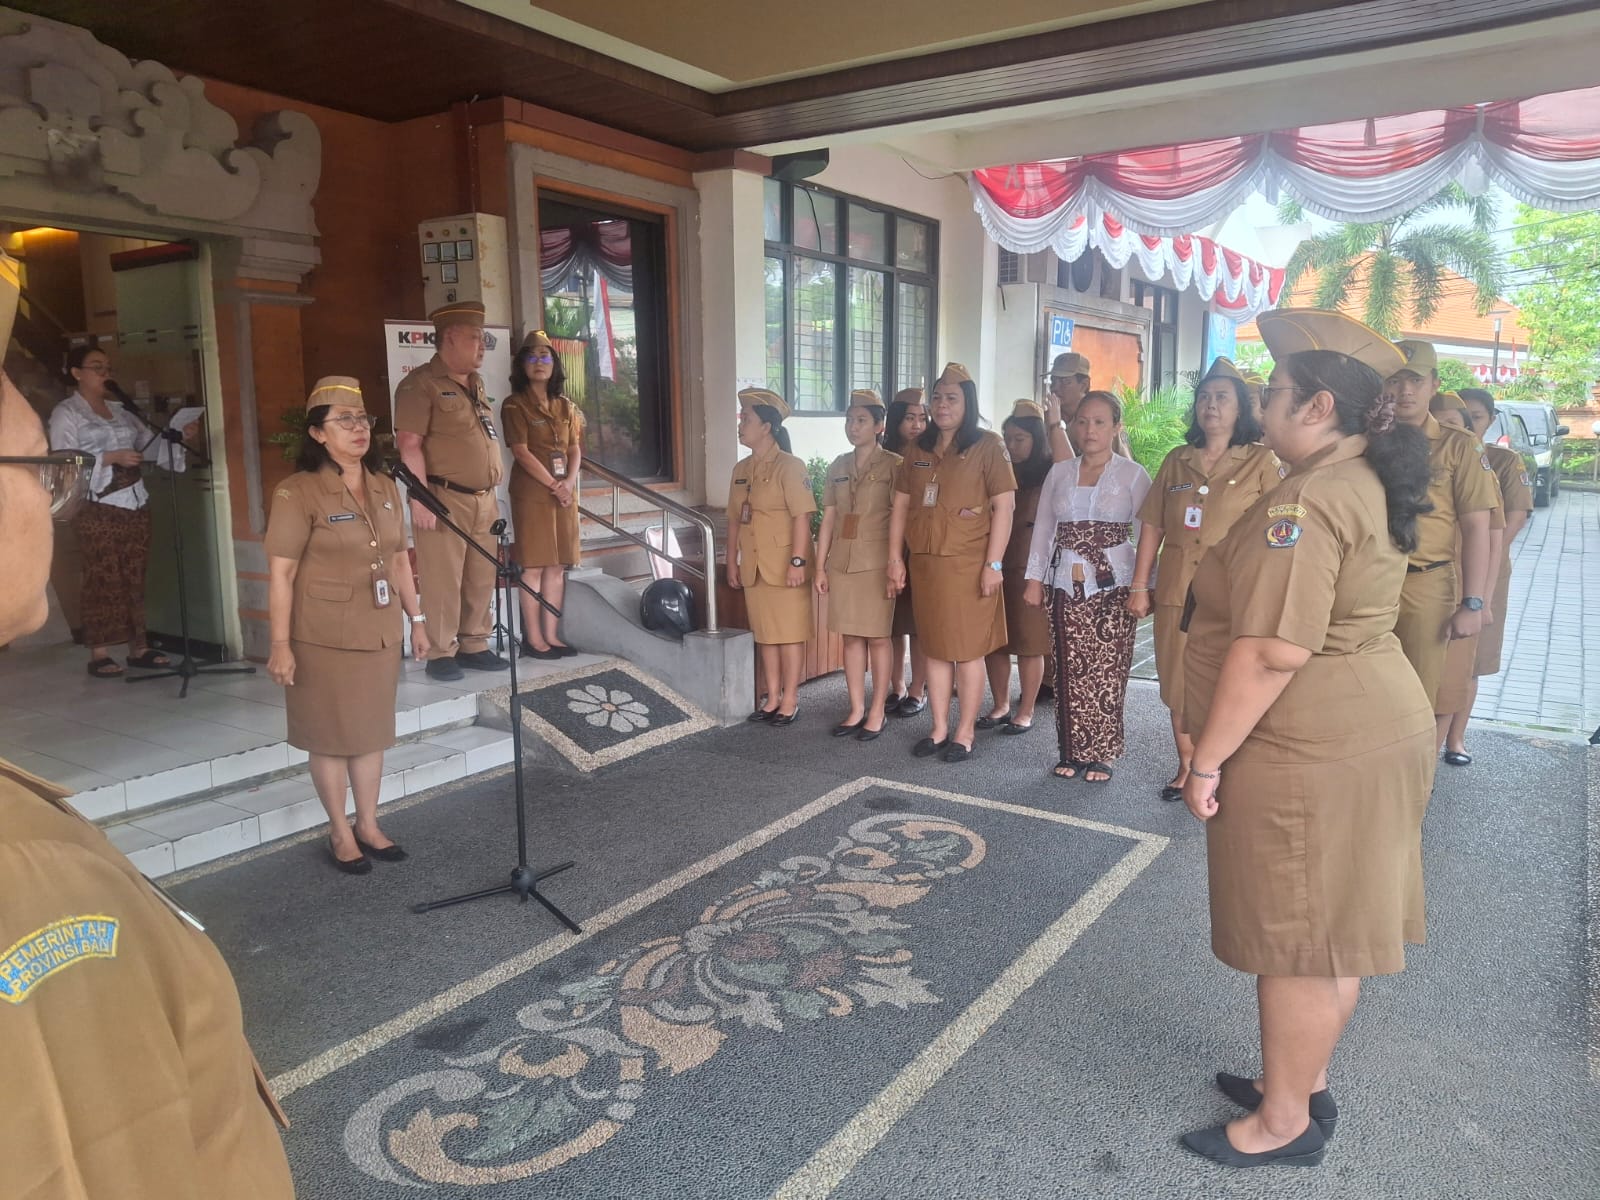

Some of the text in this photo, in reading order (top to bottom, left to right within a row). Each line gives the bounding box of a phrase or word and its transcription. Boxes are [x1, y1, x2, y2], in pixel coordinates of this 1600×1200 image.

[398, 331, 436, 344] KPK
[0, 921, 107, 980] PEMERINTAH
[10, 943, 79, 993] PROVINSI
